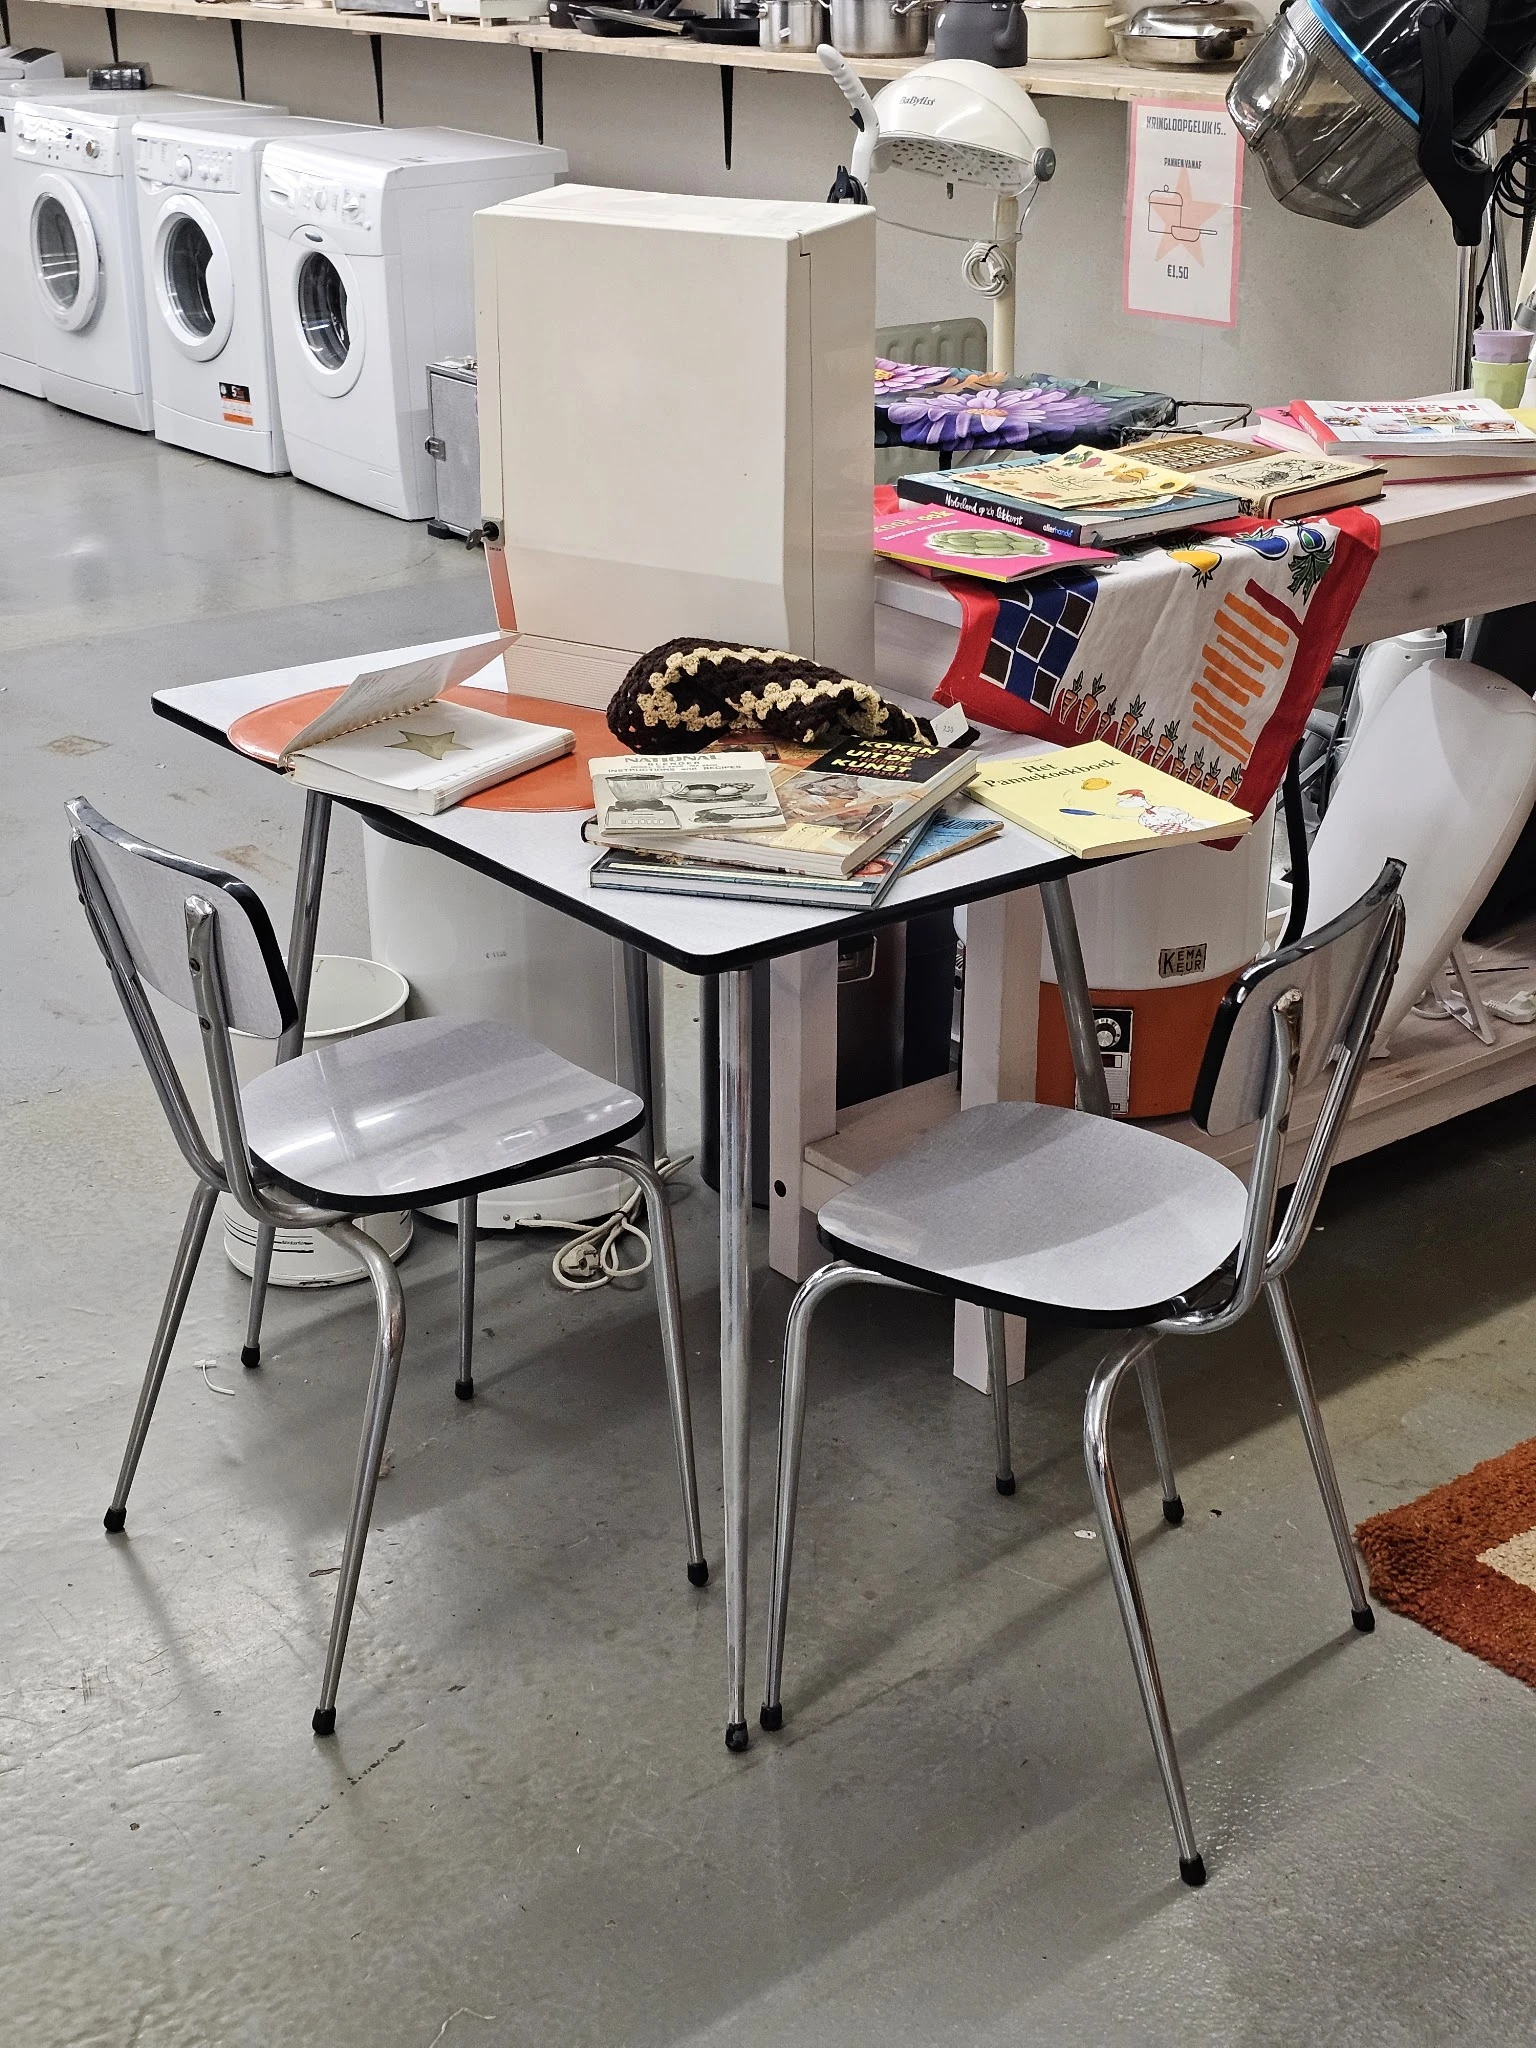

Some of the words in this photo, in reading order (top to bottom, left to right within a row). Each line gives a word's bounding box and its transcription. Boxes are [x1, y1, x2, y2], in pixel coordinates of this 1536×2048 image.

[1146, 115, 1214, 135] KRINGLOOPGELUK
[1163, 157, 1184, 168] PANNEN
[1185, 158, 1202, 170] VANAF
[945, 492, 978, 515] Nederland
[978, 505, 986, 517] op
[859, 740, 940, 755] KOKEN
[624, 754, 719, 763] NATIONAL
[845, 748, 884, 759] UIT
[883, 754, 916, 763] DE
[831, 758, 912, 774] KUNST
[981, 759, 1122, 788] Pannekoekboek
[1020, 763, 1059, 774] Het
